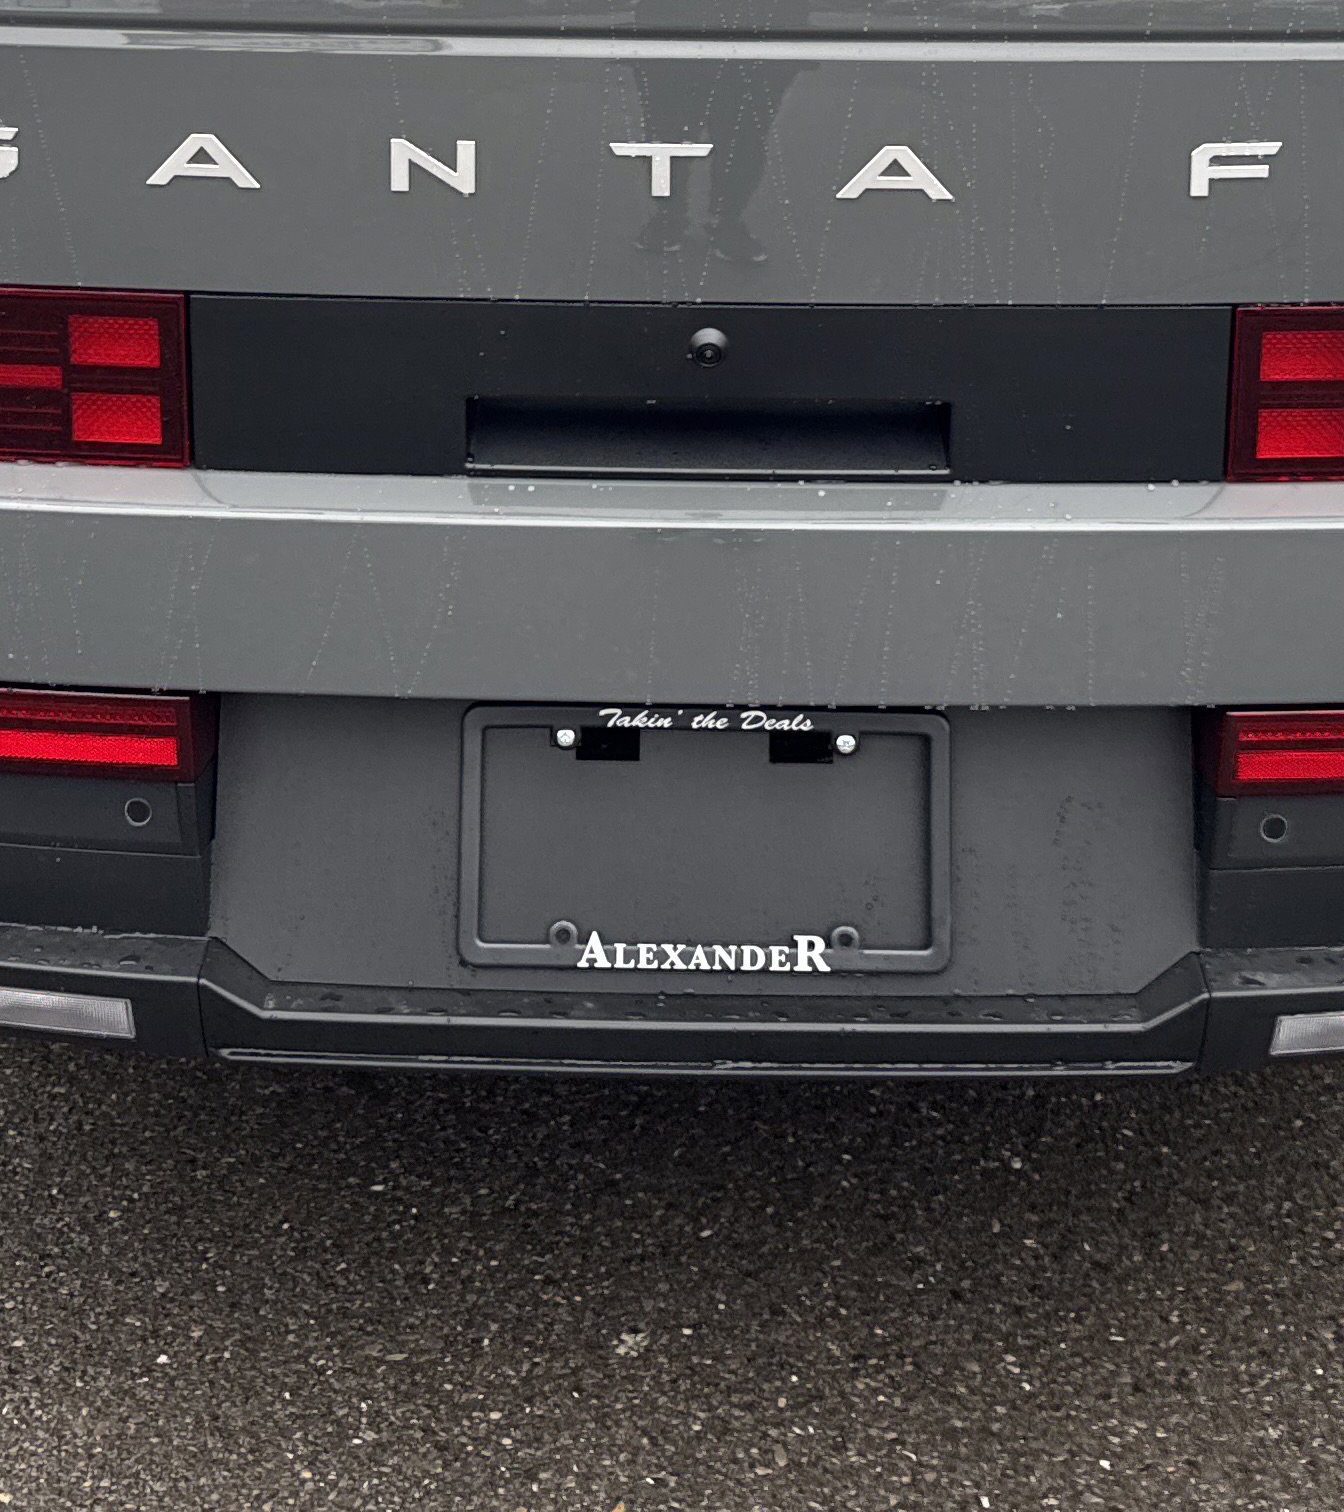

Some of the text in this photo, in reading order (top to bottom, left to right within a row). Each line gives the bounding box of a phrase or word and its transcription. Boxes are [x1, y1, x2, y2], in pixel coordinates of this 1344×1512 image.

[598, 708, 815, 732] Takin' the Deals
[575, 930, 833, 973] ALEXANDER
